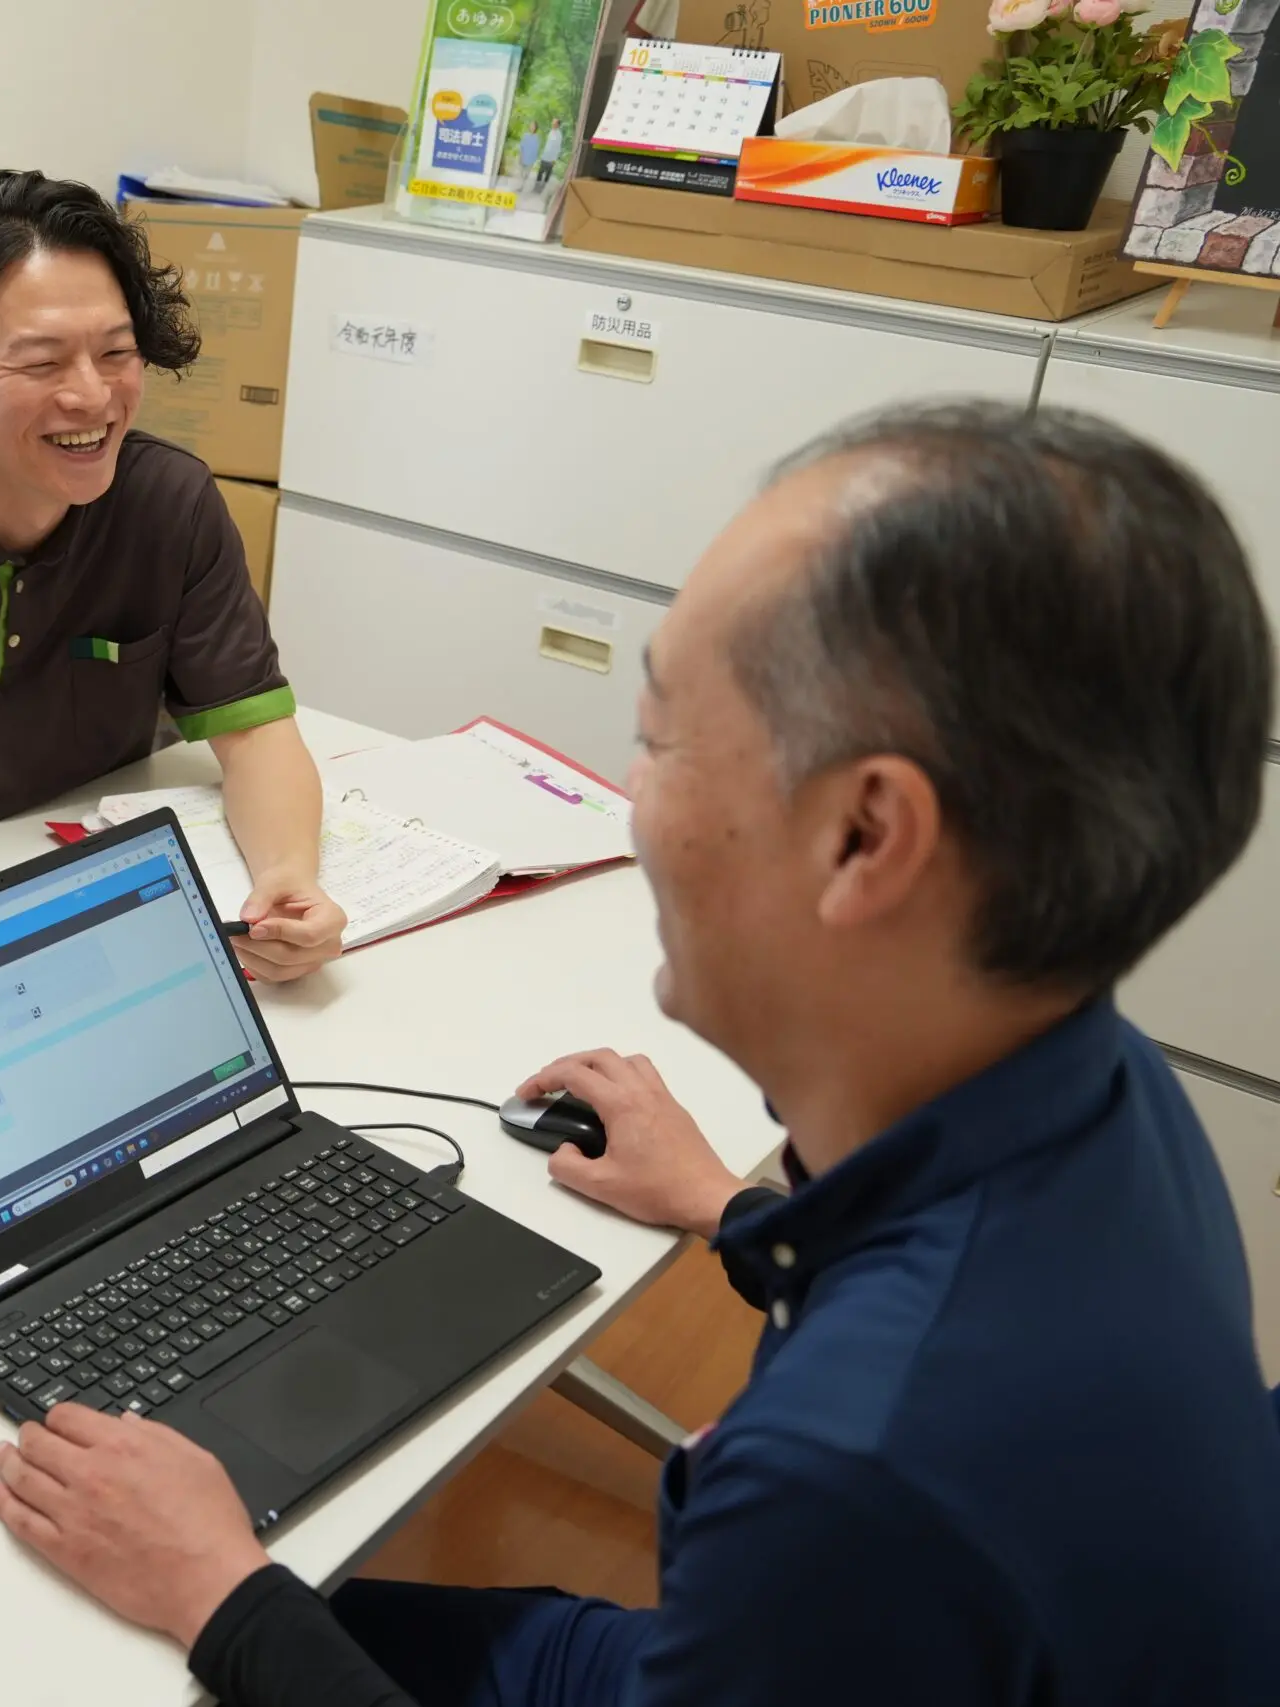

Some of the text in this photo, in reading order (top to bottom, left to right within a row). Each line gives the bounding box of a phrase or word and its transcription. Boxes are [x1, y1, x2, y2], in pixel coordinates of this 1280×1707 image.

[456, 8, 504, 28] あゆみ
[810, 0, 931, 25] PIONEER 600
[629, 48, 649, 66] 10
[439, 127, 485, 147] 司法書士
[411, 181, 513, 206] ご自由にお取りください
[877, 168, 942, 195] Kleenex
[892, 188, 920, 197] クリネックス
[337, 320, 417, 355] 令和元年度
[592, 314, 653, 340] 防災用品
